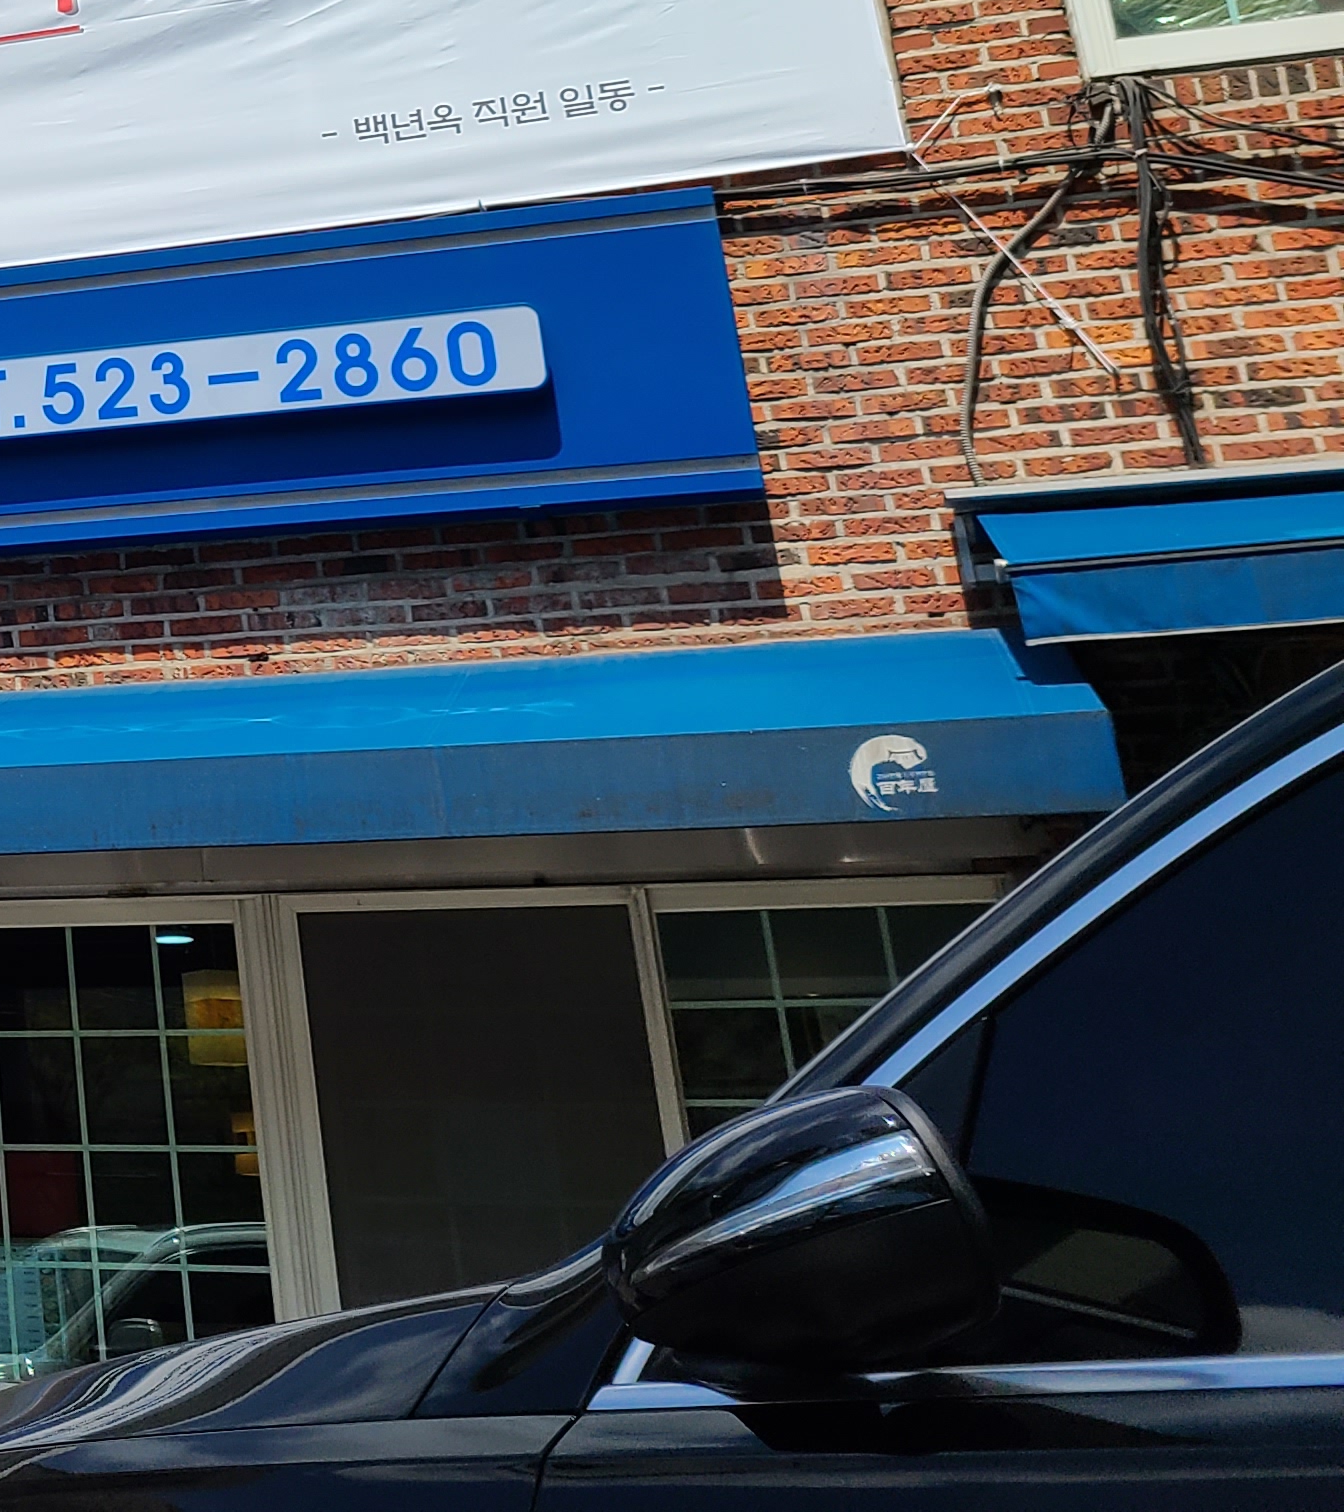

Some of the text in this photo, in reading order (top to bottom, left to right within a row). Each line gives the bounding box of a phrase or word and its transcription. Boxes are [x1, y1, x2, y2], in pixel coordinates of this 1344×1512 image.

[353, 104, 463, 145] 백년옥
[472, 92, 549, 129] 직원
[560, 79, 635, 120] 일동
